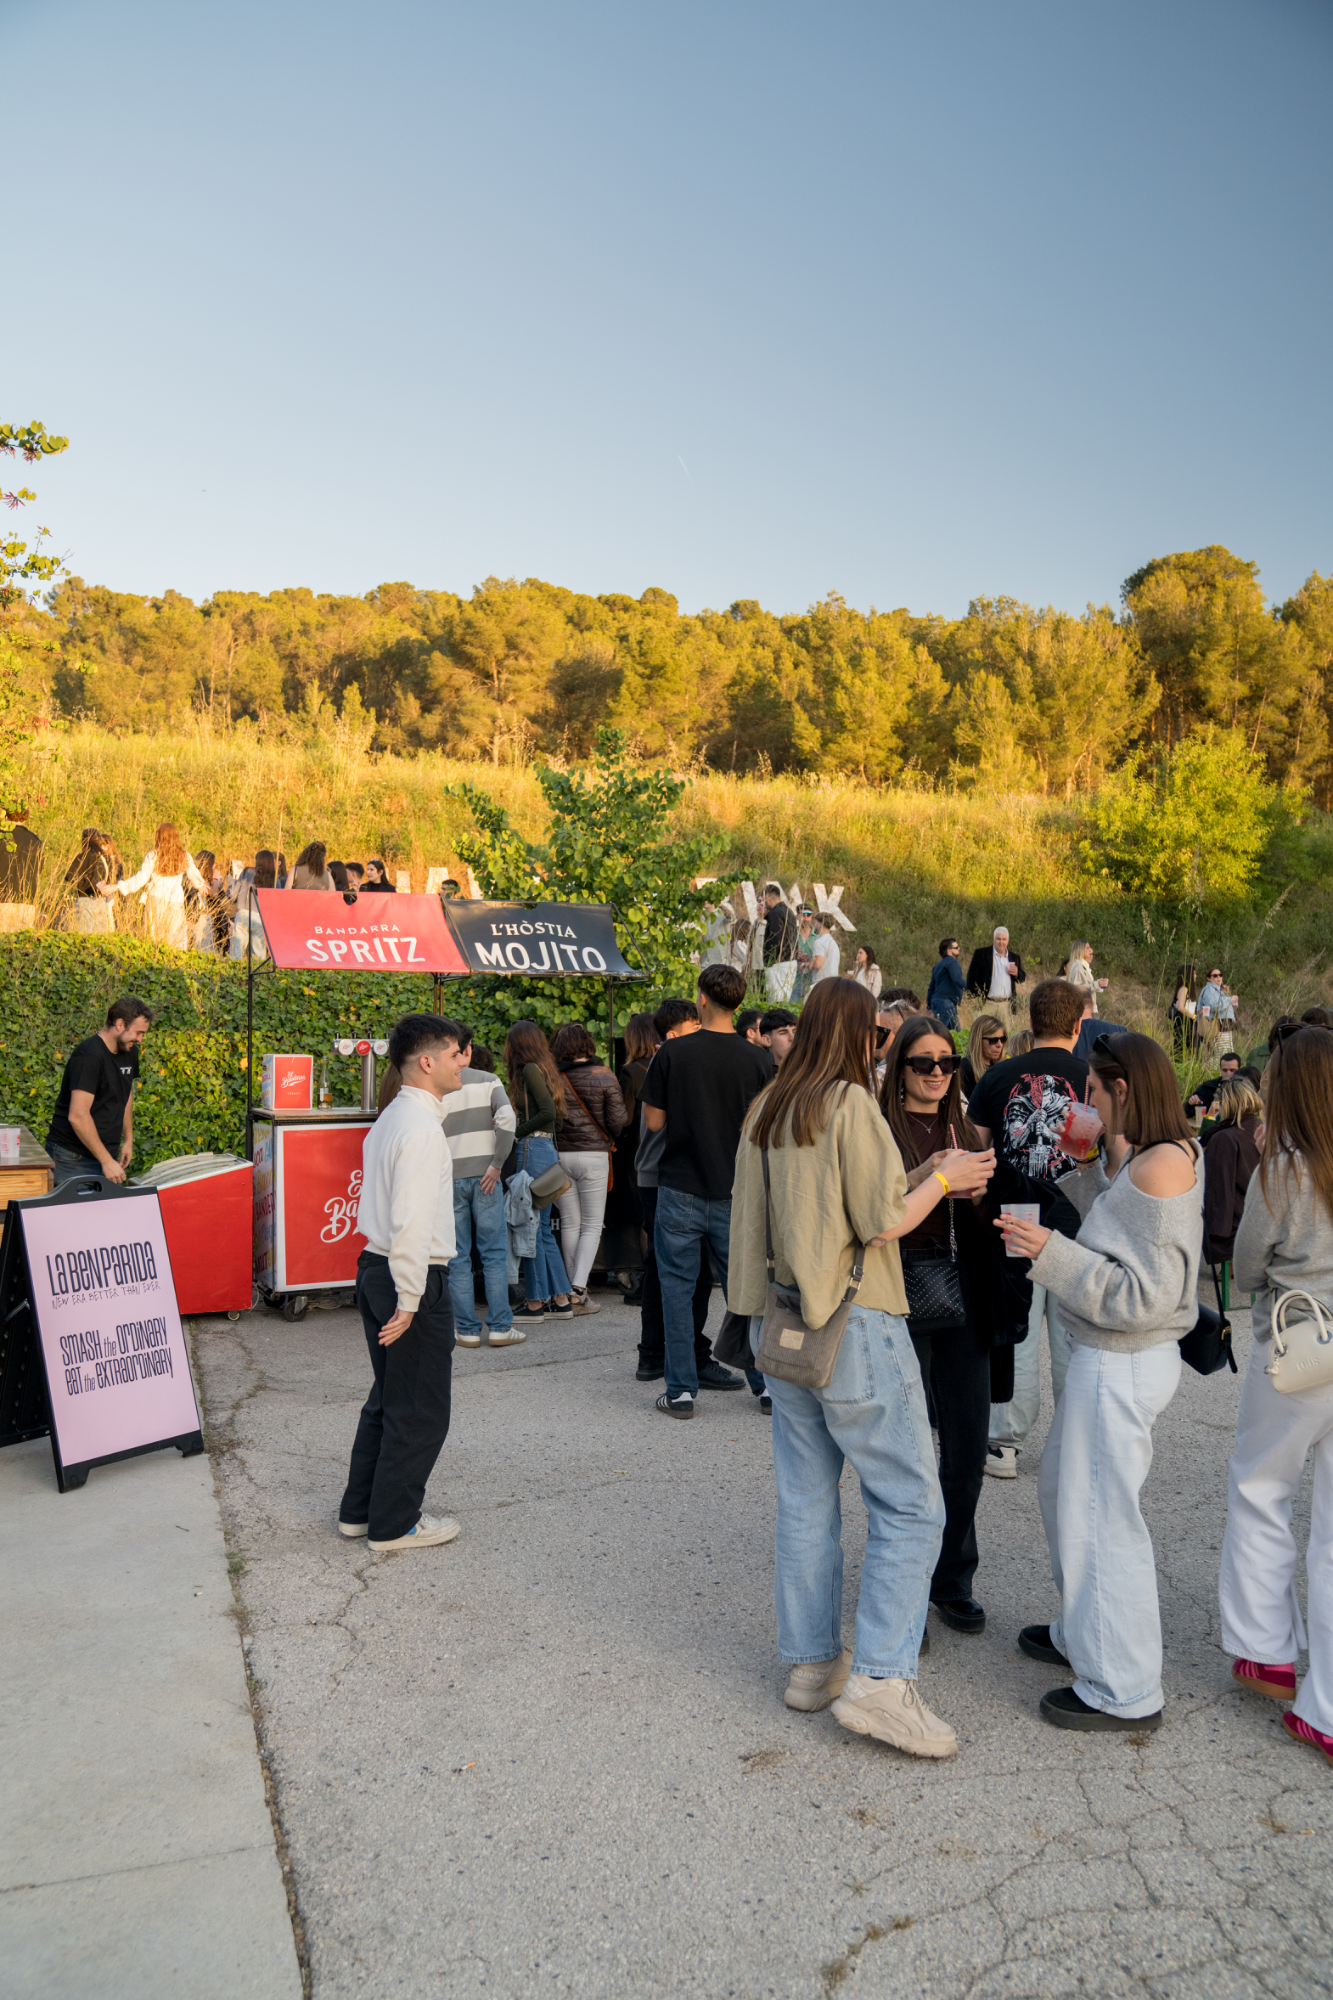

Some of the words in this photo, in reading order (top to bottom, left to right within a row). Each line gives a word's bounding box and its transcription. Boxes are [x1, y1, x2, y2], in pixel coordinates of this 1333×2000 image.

[314, 924, 401, 935] BANDARRA
[490, 919, 578, 939] L'HÒSTIA
[305, 936, 426, 964] SPRITZ
[473, 940, 608, 972] MOJITO
[51, 1296, 70, 1310] NEW
[71, 1291, 87, 1306] ERA
[88, 1286, 120, 1302] BETTER
[121, 1282, 141, 1296] THAN
[142, 1280, 161, 1293] EVER
[103, 1336, 117, 1358] the
[84, 1373, 96, 1393] the
